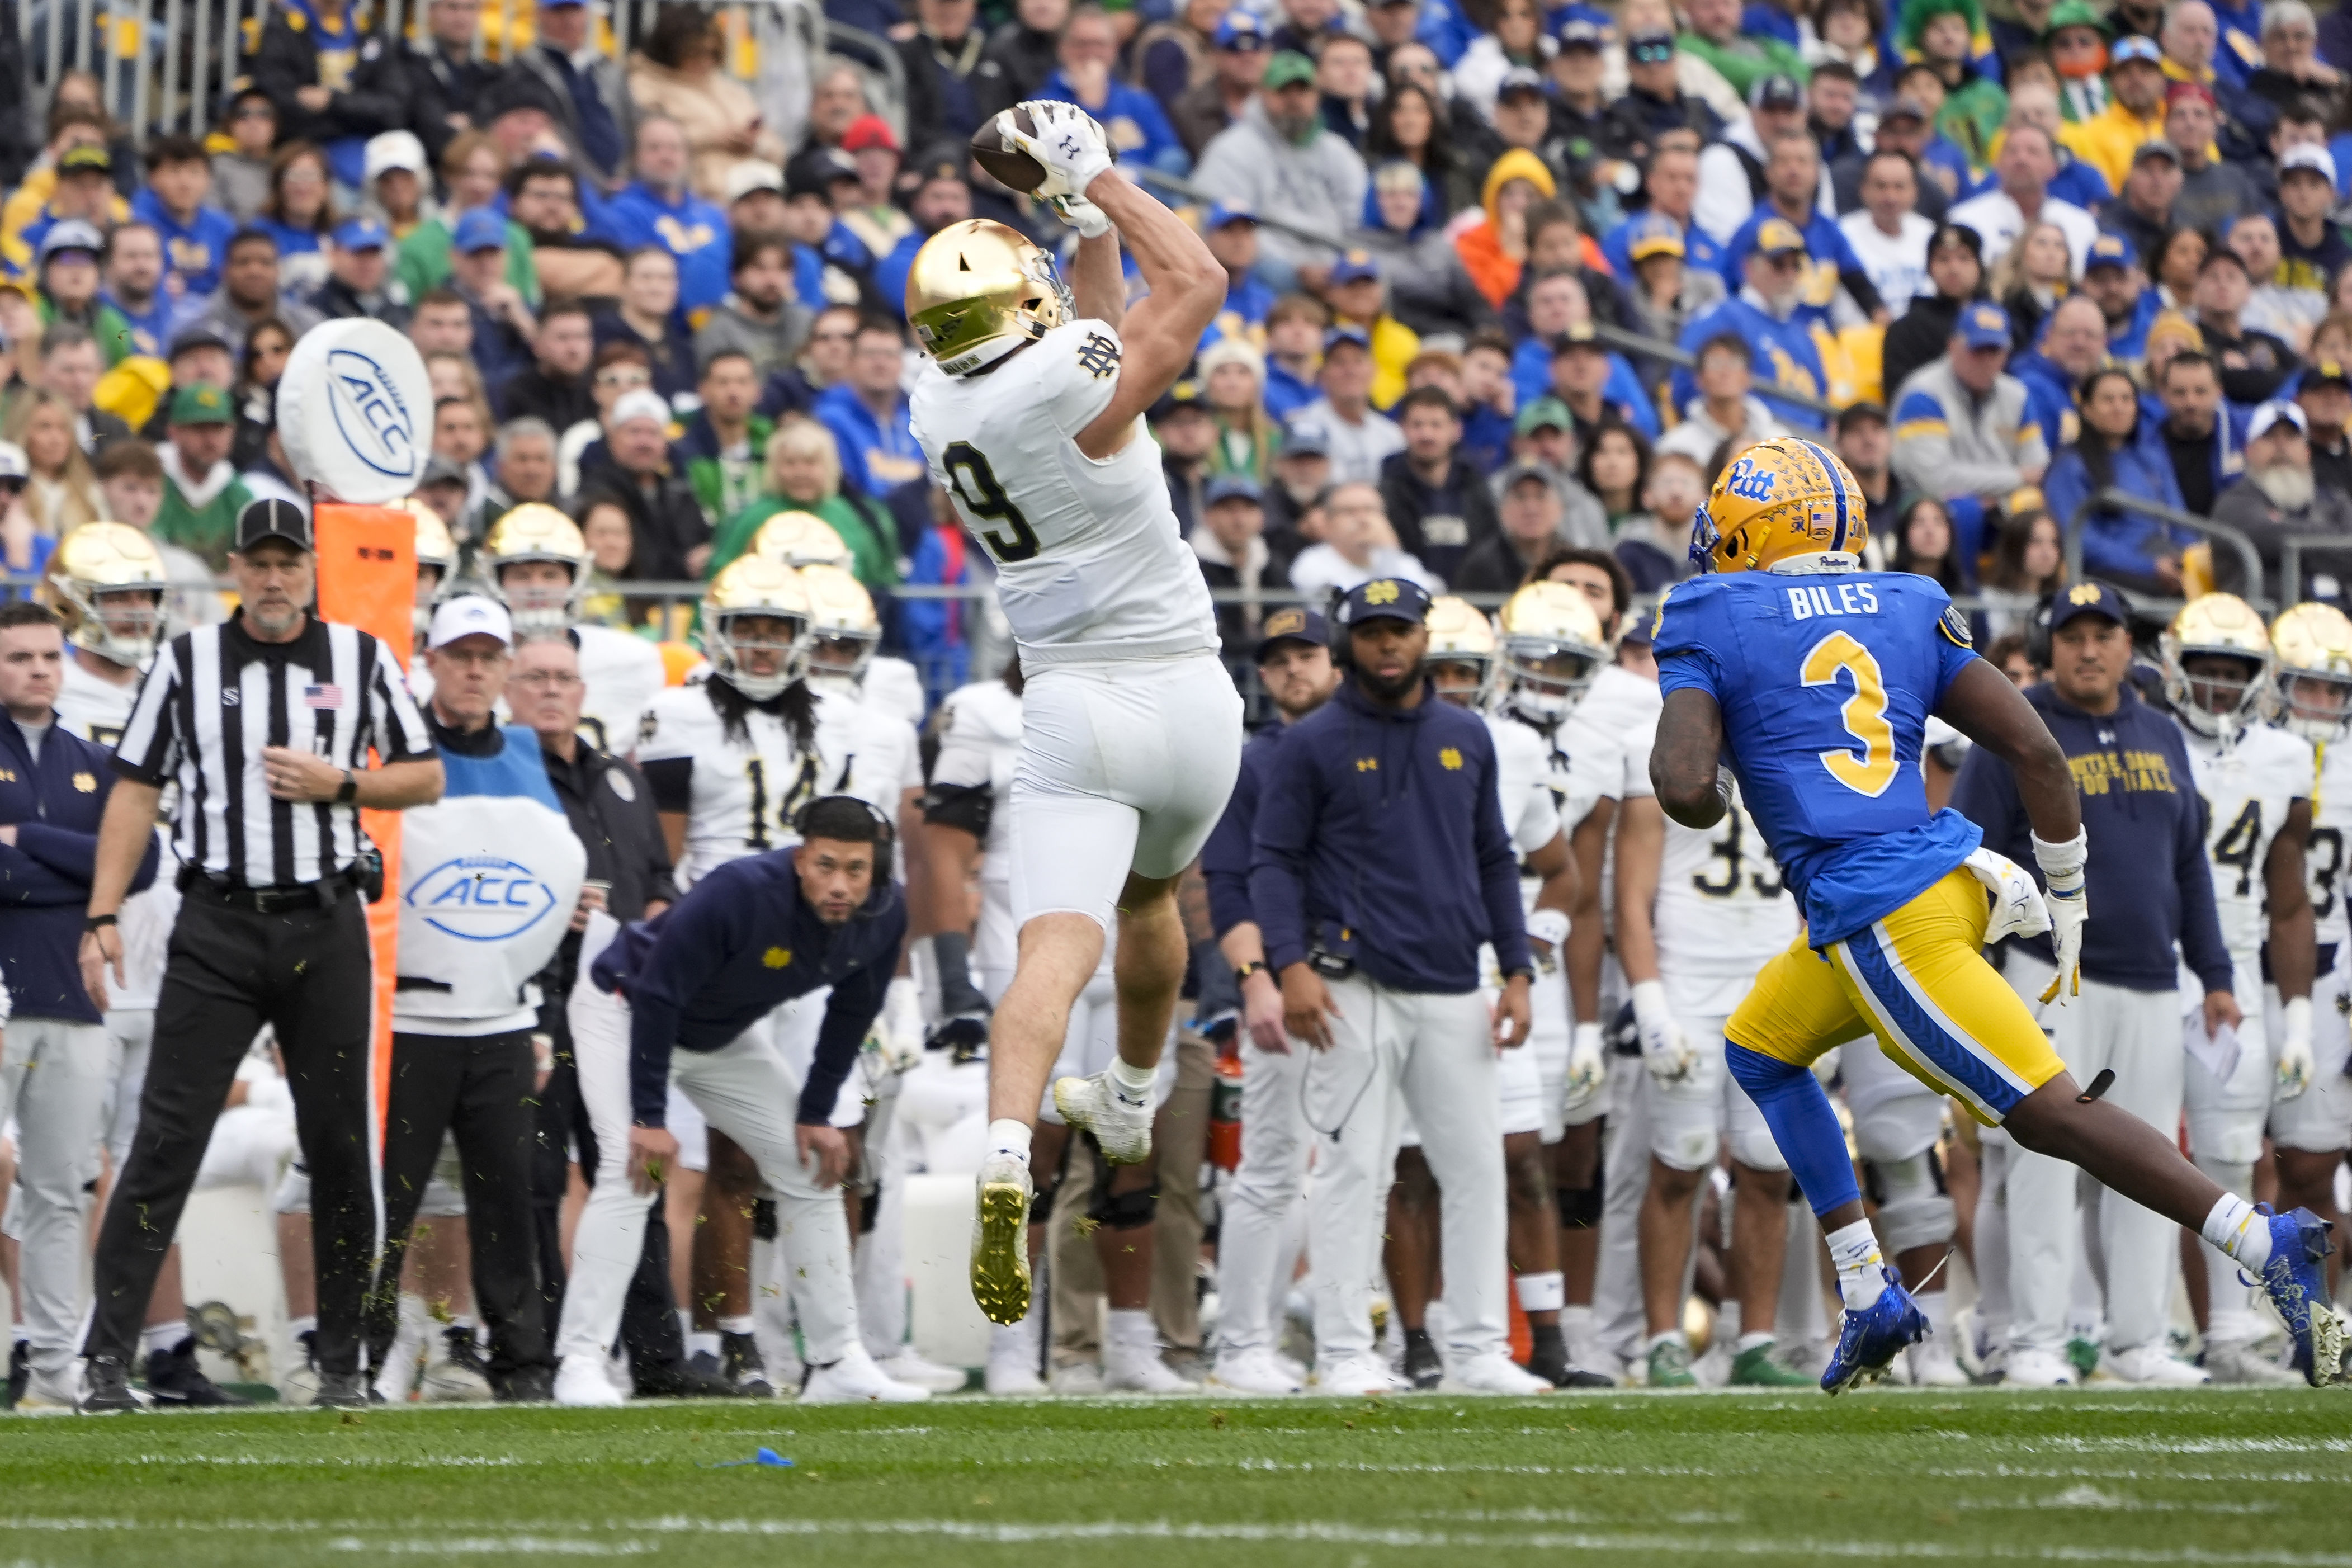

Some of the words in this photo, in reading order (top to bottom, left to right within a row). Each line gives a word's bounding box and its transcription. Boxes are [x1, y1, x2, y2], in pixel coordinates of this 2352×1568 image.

[339, 375, 409, 455] ACC
[942, 440, 1041, 562] 9
[1725, 457, 1776, 502] Pitt
[1787, 582, 1879, 621] BILES
[1800, 630, 1901, 799] 3
[429, 877, 535, 906] ACC
